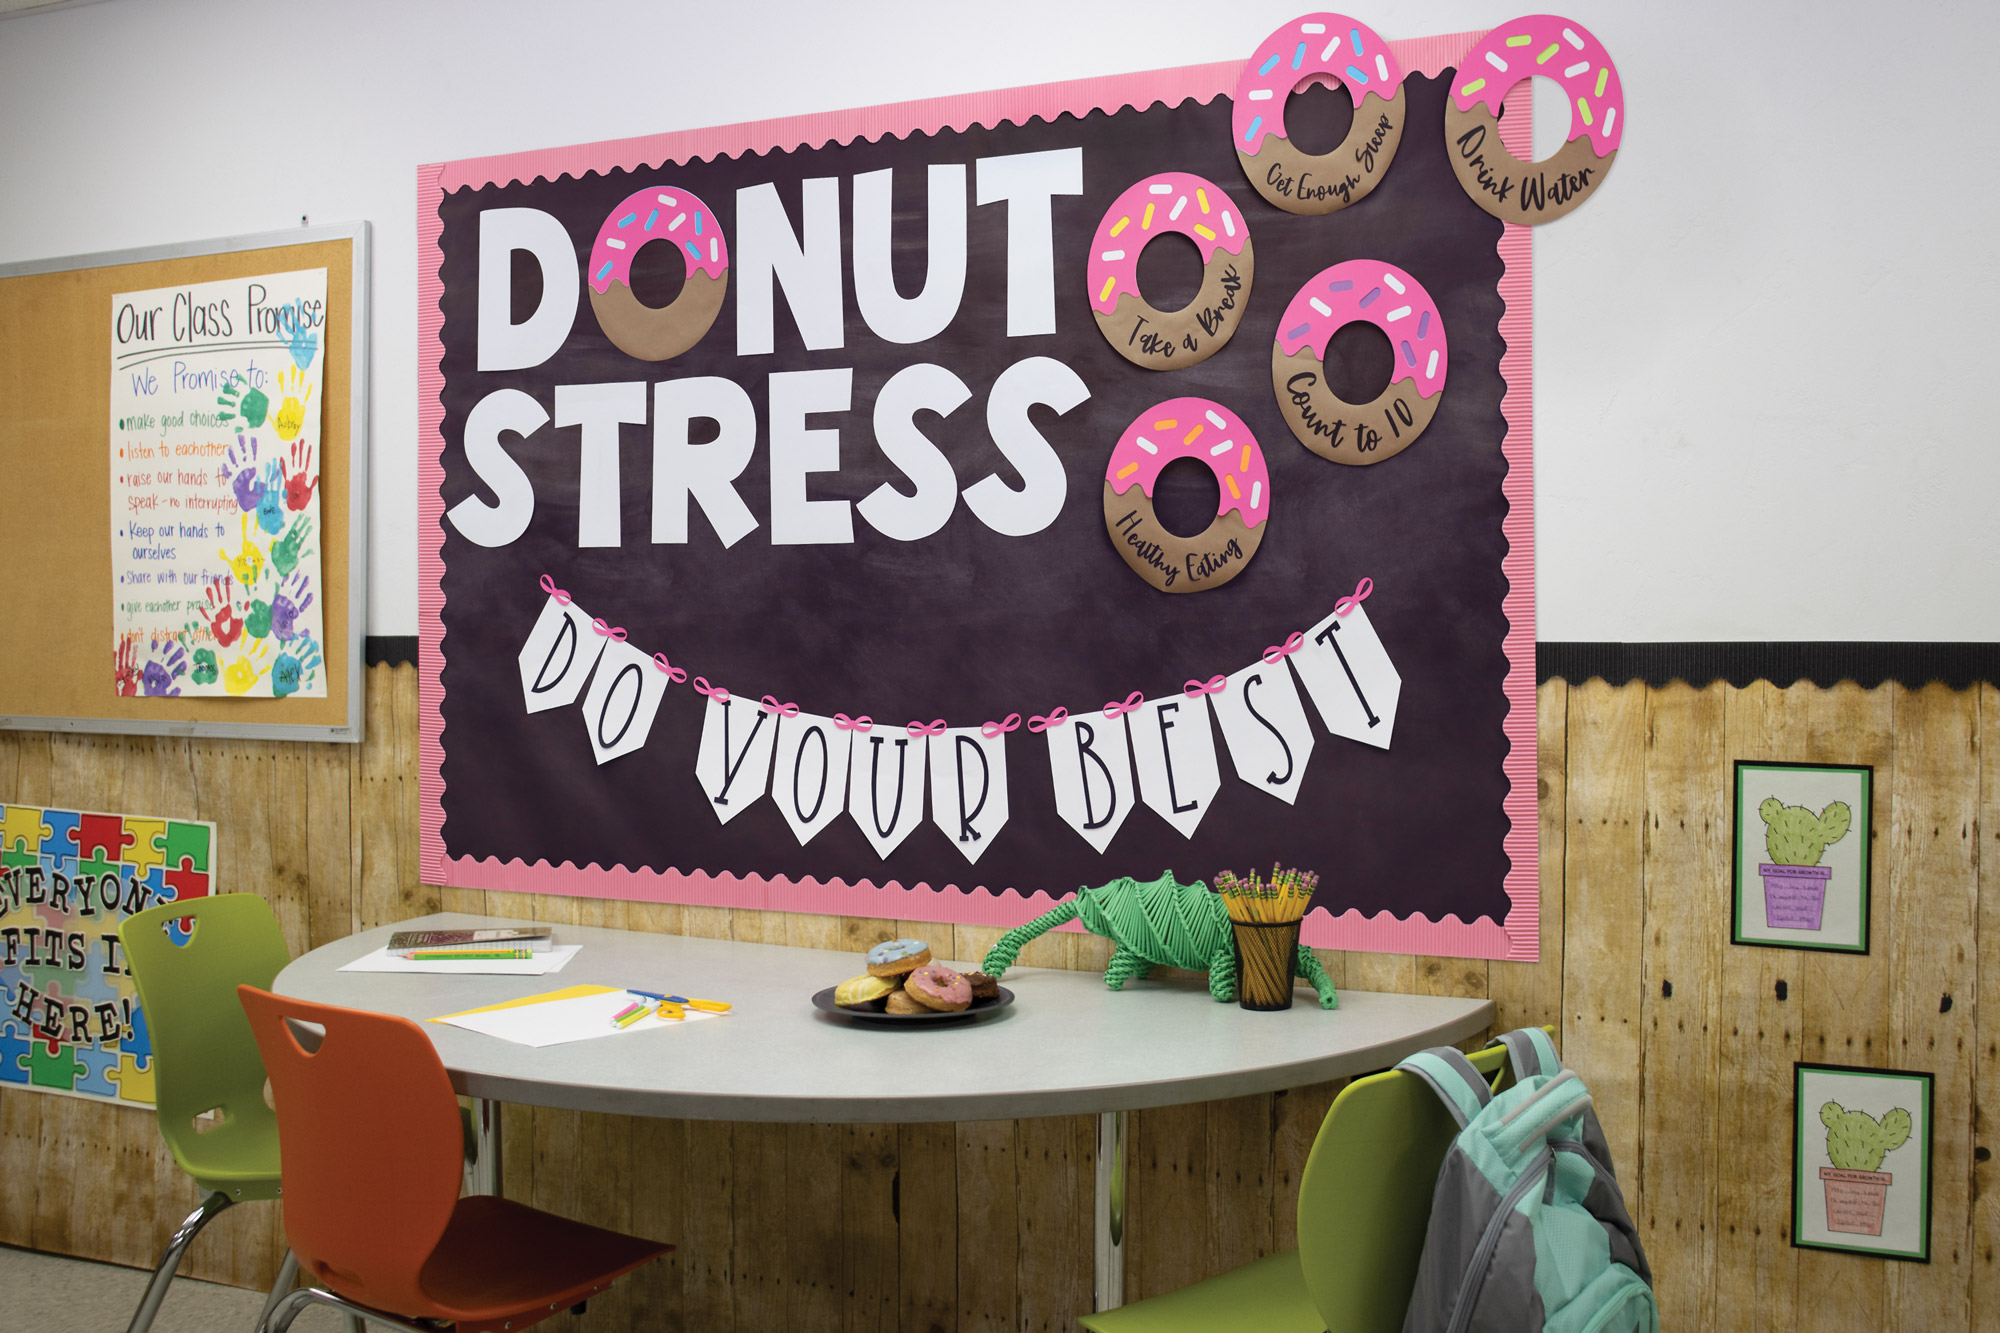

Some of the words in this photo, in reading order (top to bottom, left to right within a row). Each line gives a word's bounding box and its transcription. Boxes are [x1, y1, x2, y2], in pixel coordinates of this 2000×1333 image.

[1266, 162, 1295, 197] Get
[1297, 172, 1361, 204] Enough
[1355, 112, 1393, 174] Sleep
[1456, 124, 1515, 203] Drink
[1520, 168, 1595, 211] Water
[477, 146, 1084, 373] DONUT
[116, 303, 163, 344] Our
[173, 290, 233, 343] Class
[248, 283, 324, 334] Promise
[1128, 314, 1176, 358] Take
[1182, 333, 1198, 352] a
[1196, 263, 1242, 338] Break
[132, 366, 158, 397] We
[174, 360, 240, 394] Promise
[247, 359, 269, 389] to:
[126, 412, 155, 431] make
[160, 410, 184, 438] good
[190, 409, 229, 429] choices
[1286, 371, 1347, 448] Count
[1353, 423, 1383, 453] to
[1384, 398, 1414, 438] 10
[127, 440, 154, 461] listen
[158, 440, 170, 457] to
[175, 440, 229, 457] eachother
[127, 473, 152, 487] raise
[157, 471, 173, 485] our
[177, 467, 208, 487] hands
[215, 467, 227, 488] to
[446, 356, 1092, 549] STRESS
[128, 493, 159, 515] speak
[169, 497, 180, 508] no
[185, 492, 239, 515] interrupting
[129, 520, 155, 545] Keep
[158, 524, 174, 537] our
[179, 521, 209, 539] hands
[215, 521, 225, 538] to
[132, 543, 177, 560] ourselves
[1115, 510, 1181, 587] Healthy
[1186, 537, 1243, 582] Eating
[126, 569, 151, 585] Share
[157, 567, 178, 584] with
[183, 571, 198, 585] our
[201, 567, 234, 585] friends
[126, 600, 142, 622] give
[186, 599, 214, 616] praise
[531, 610, 643, 749] DO
[713, 698, 990, 843] YOUR
[1074, 619, 1382, 830] BEST
[0, 866, 171, 921] VERYON
[1, 927, 86, 970] FITS
[101, 934, 132, 976] I
[12, 981, 134, 1043] HERE!
